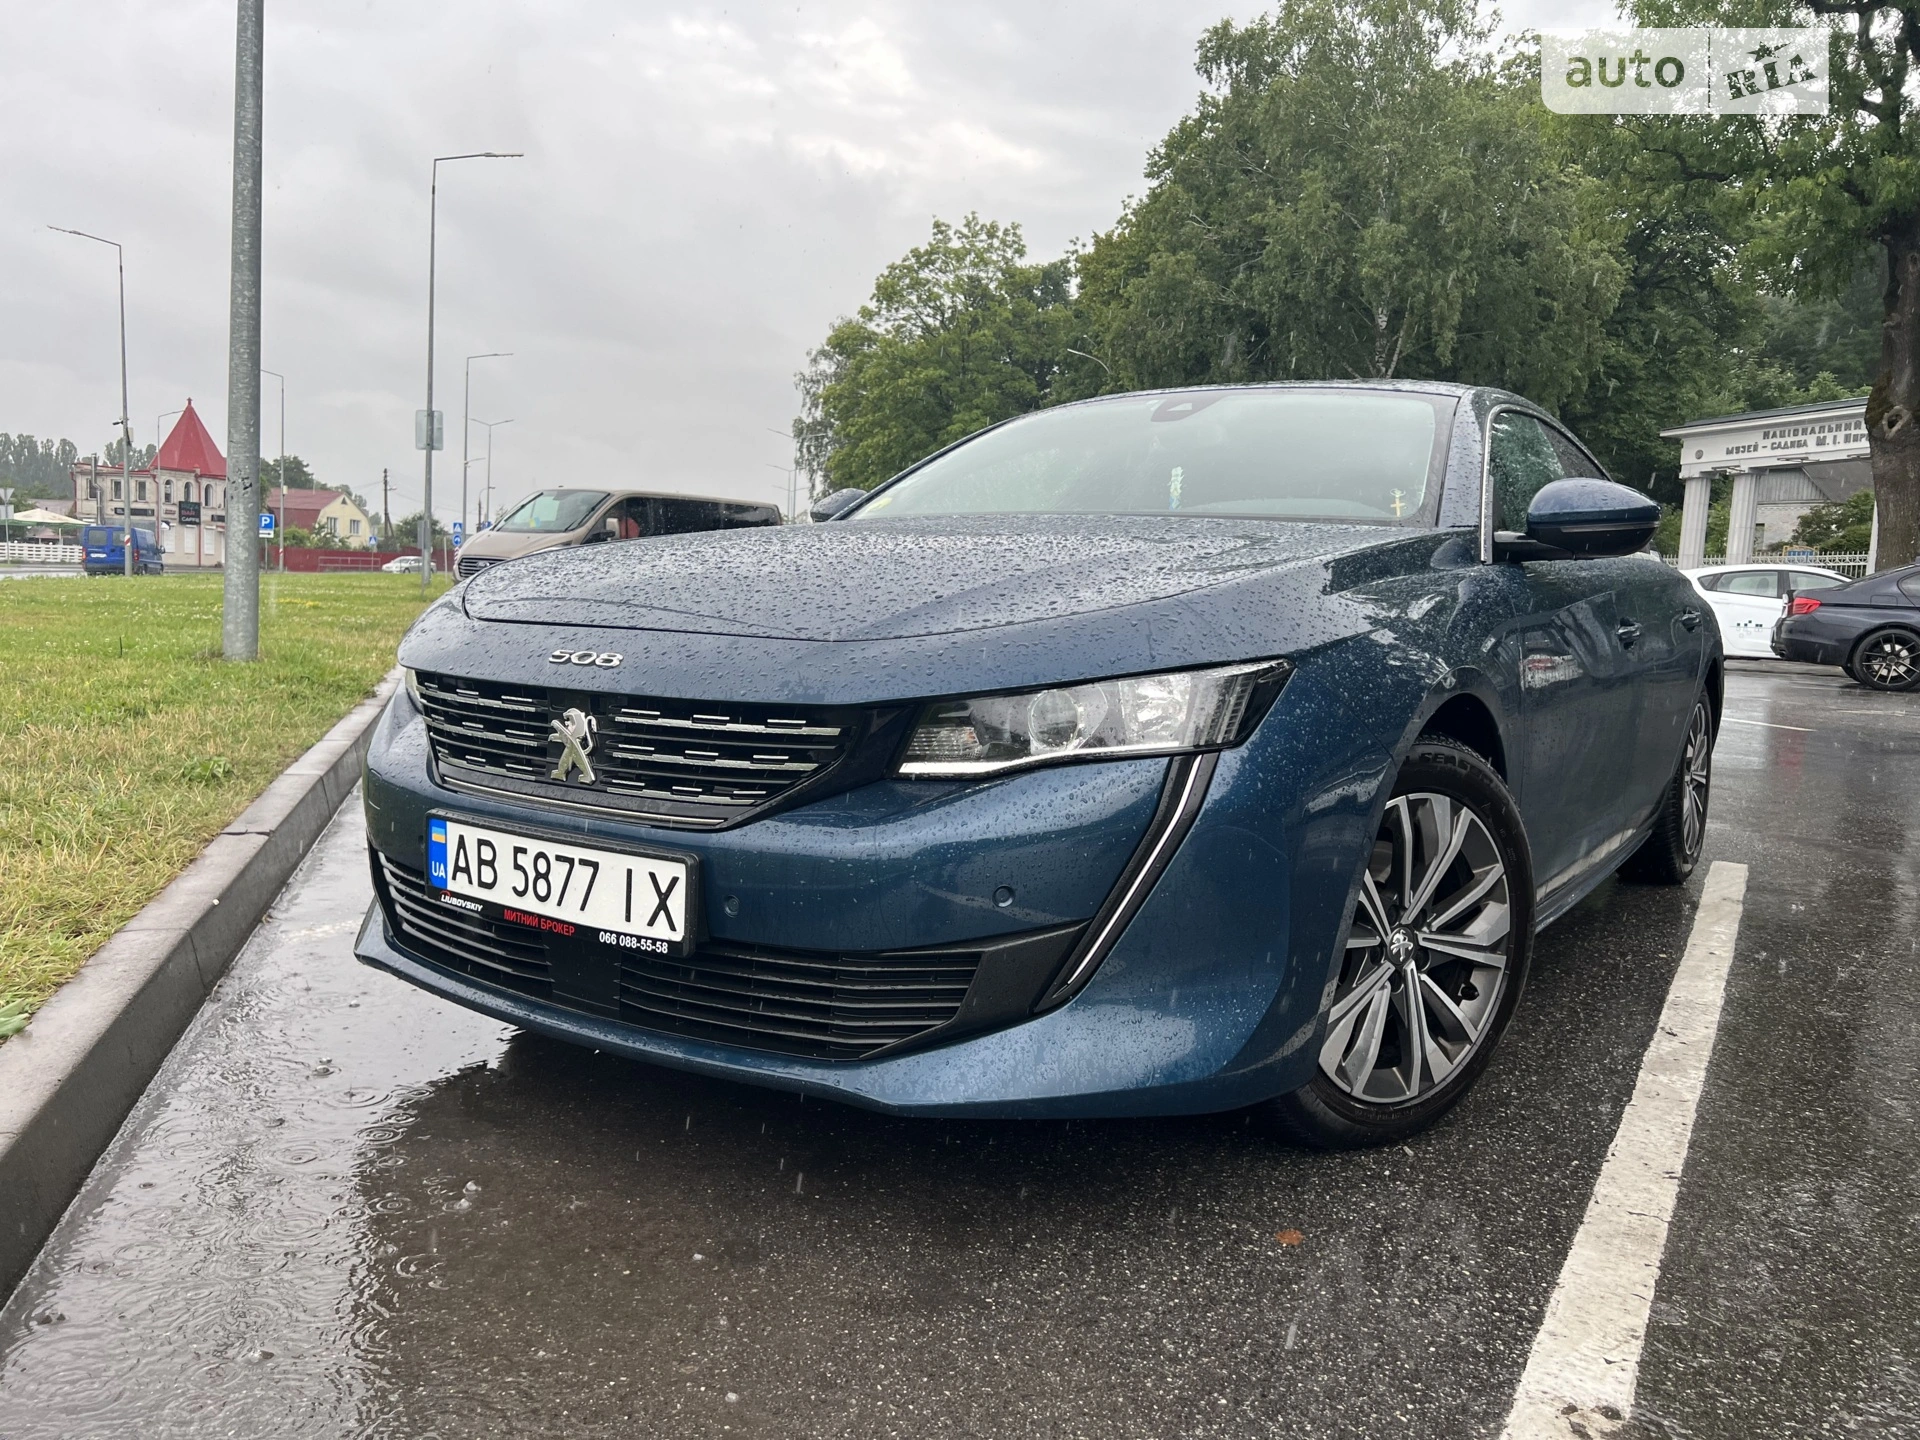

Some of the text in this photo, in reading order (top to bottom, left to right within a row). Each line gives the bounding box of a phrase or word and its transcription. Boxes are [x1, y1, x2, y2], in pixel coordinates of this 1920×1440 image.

[1726, 441, 1759, 455] МУЗЕЙ
[1771, 439, 1808, 451] САДИБА
[261, 516, 271, 528] P
[549, 649, 624, 667] 508
[432, 834, 680, 932] UA AB 5877 IX
[503, 908, 575, 936] МИТНИЙ БРОКЕР
[599, 931, 668, 954] 066 088-55-58
